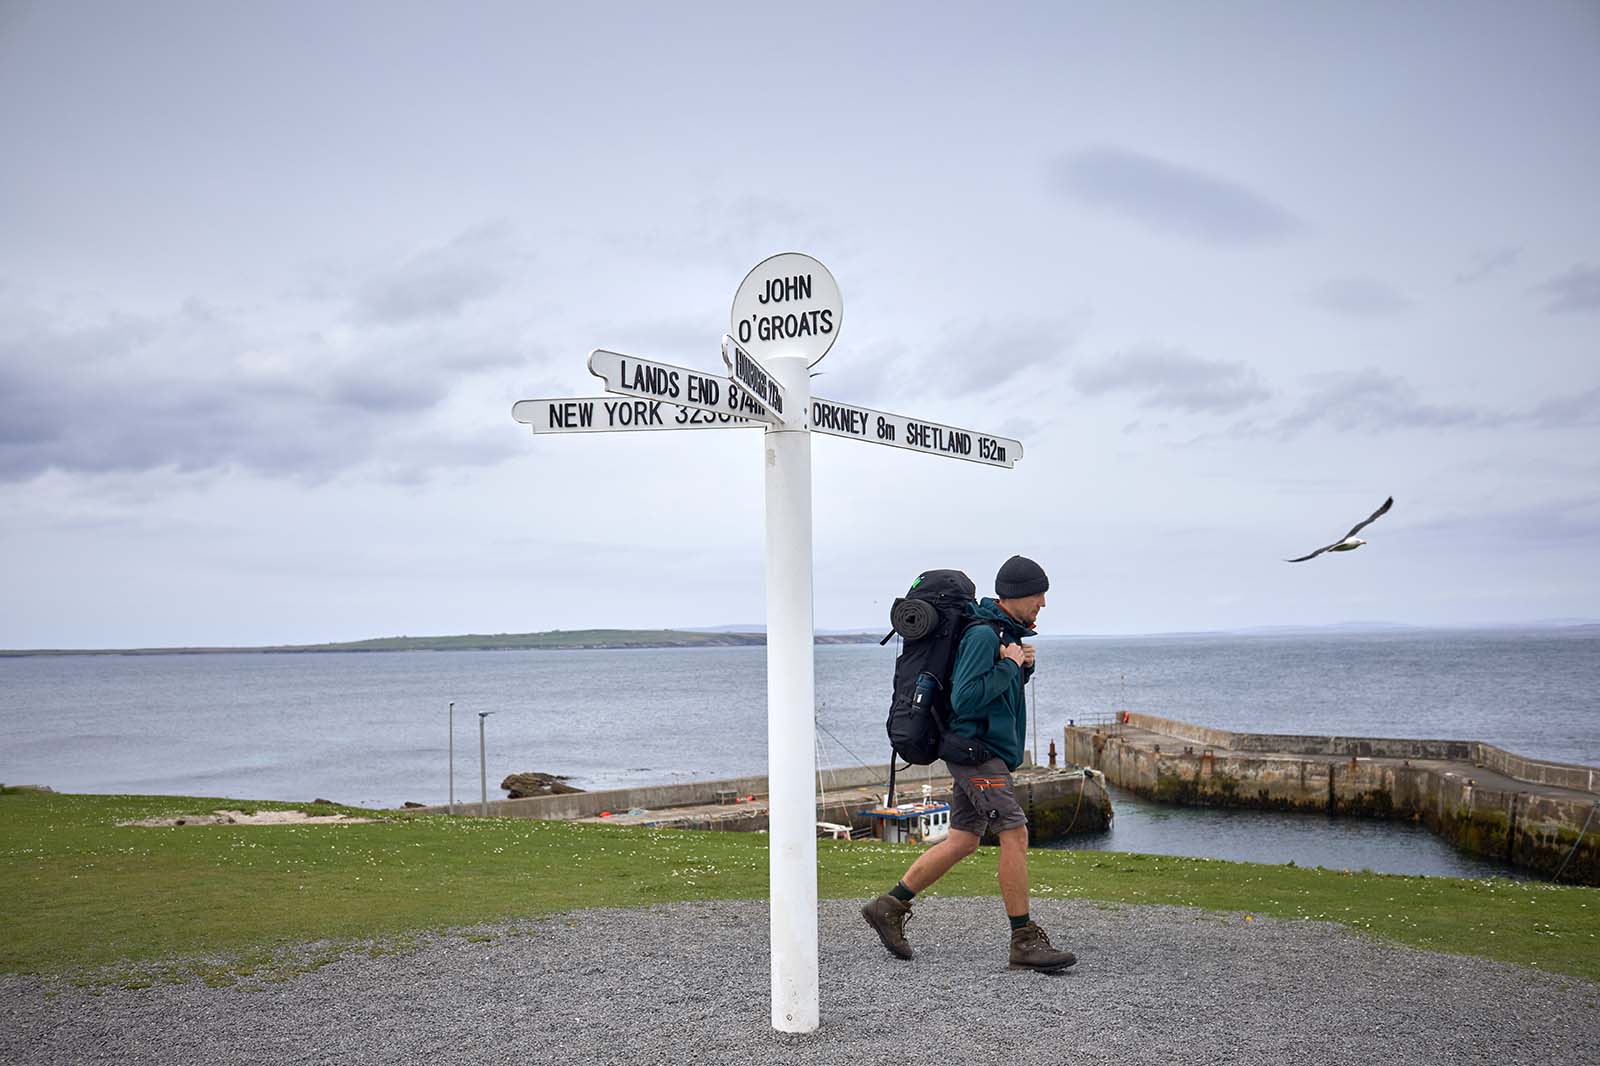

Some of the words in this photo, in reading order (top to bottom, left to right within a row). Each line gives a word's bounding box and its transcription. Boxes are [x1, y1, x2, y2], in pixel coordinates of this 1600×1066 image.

[759, 274, 811, 304] JOHN
[738, 309, 833, 343] O'GROATS
[621, 360, 679, 398] LANDS
[687, 375, 720, 406] END
[549, 402, 593, 428] NEW
[605, 401, 663, 426] YORK
[812, 402, 869, 436] ORKNEY
[876, 416, 896, 442] 8m
[906, 422, 972, 455] SHETLAND
[978, 436, 1007, 463] 152m
